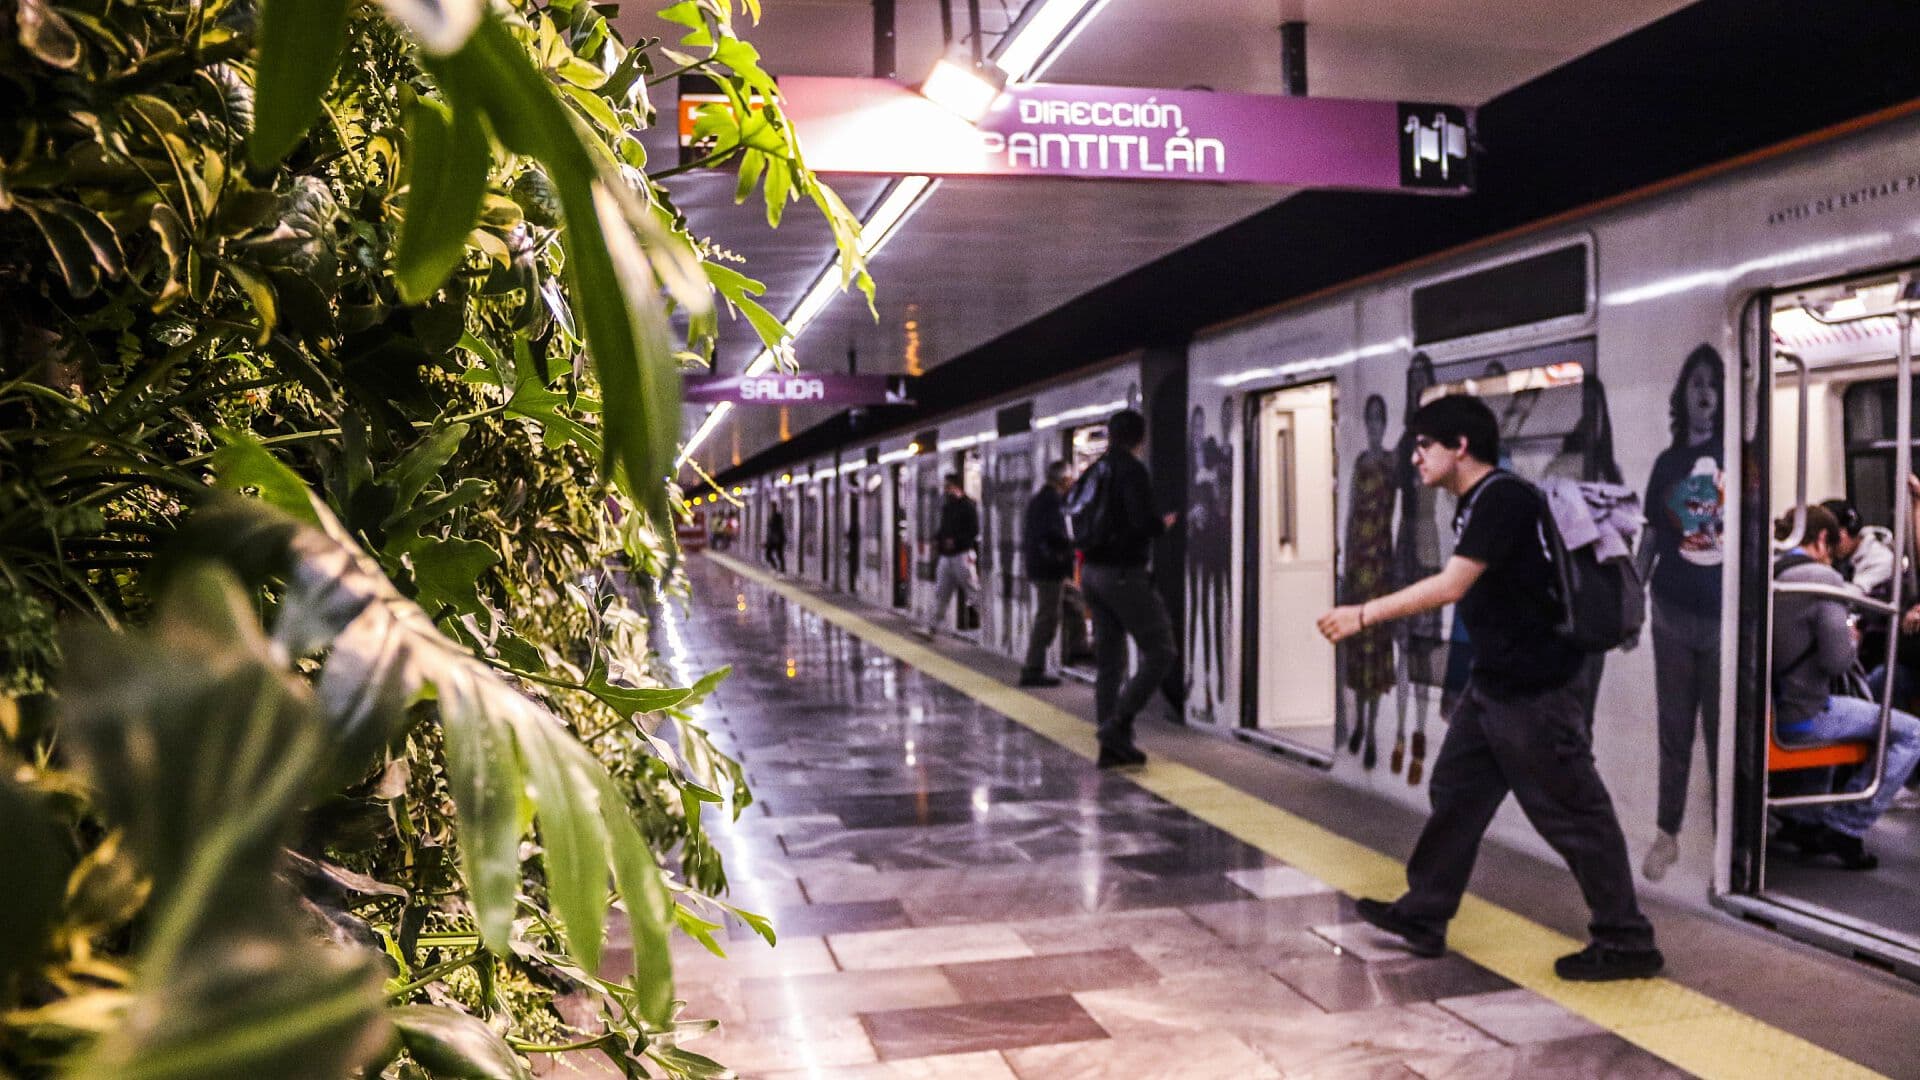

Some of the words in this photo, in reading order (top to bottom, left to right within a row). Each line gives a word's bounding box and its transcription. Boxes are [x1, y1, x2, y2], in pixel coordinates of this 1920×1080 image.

[1019, 96, 1182, 129] DIRECCIÓN
[983, 126, 1225, 174] PANTITLÁN
[740, 379, 824, 400] SALIDA
